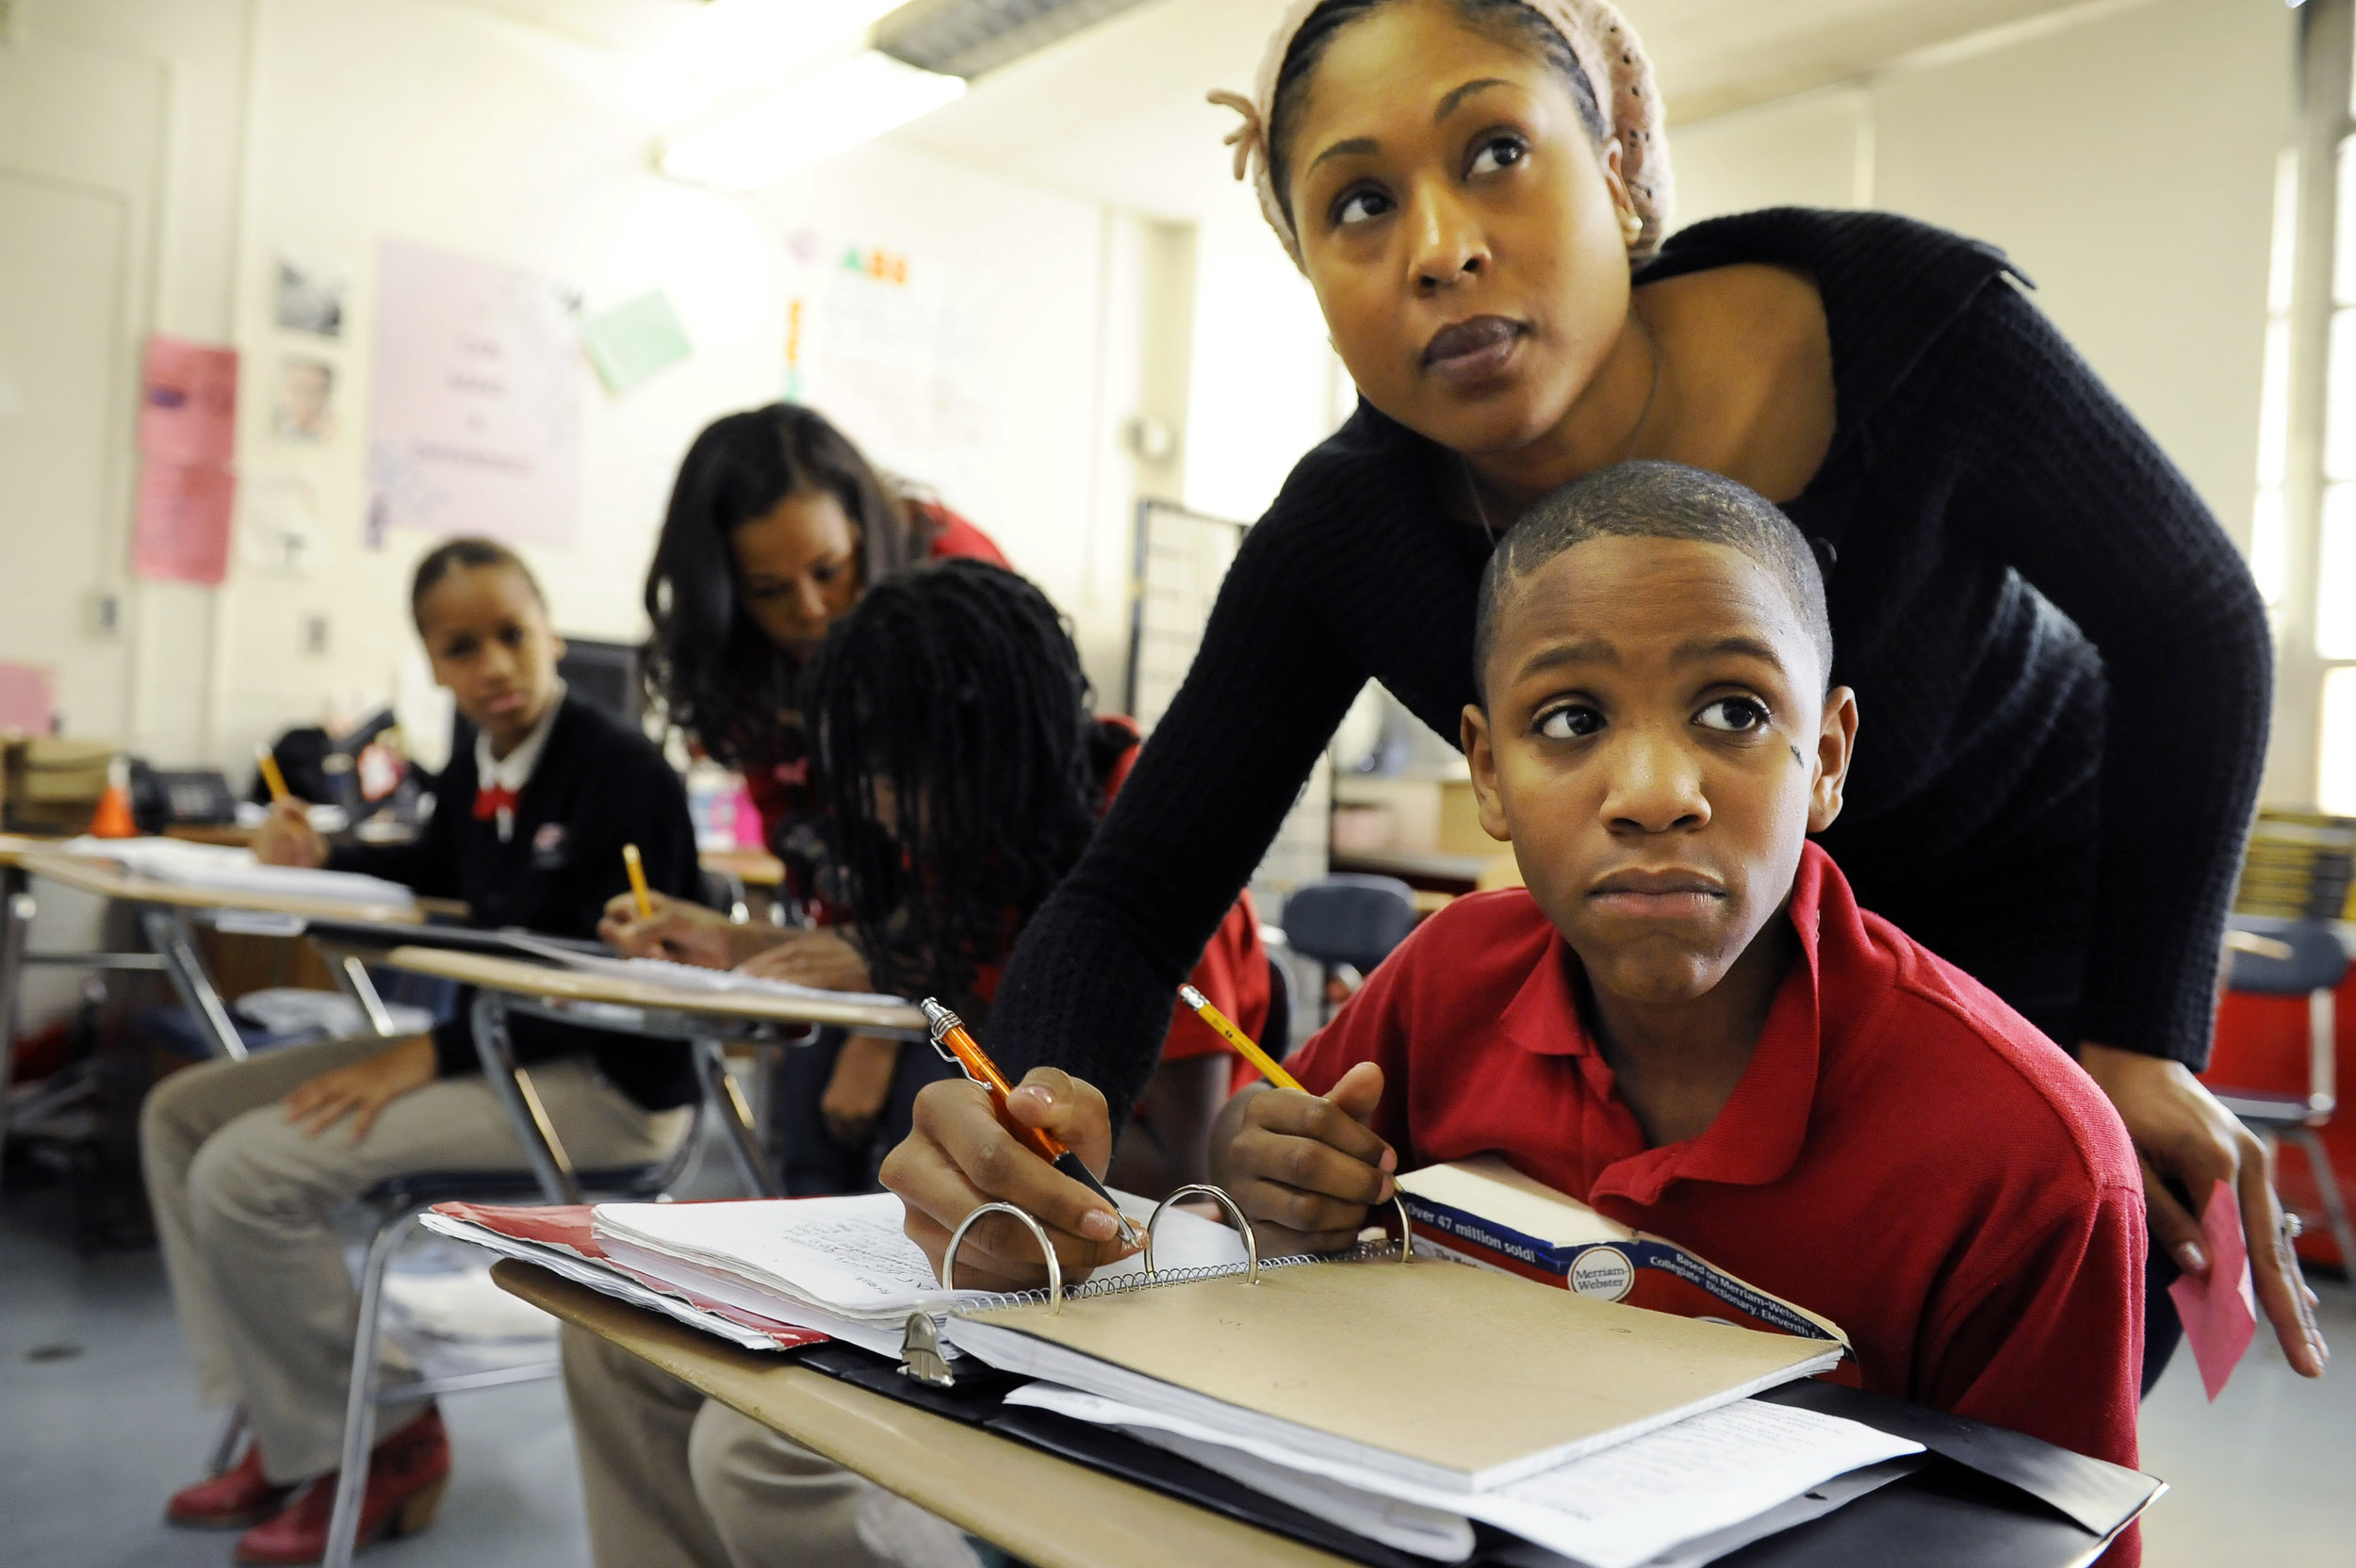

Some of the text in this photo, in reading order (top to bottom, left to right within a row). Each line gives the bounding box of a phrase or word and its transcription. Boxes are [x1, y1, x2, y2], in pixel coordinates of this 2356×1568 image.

[1407, 1202, 1536, 1263] Over 47 million sold!
[1576, 1268, 1628, 1280] Merriam-
[1677, 1253, 1705, 1275] Based
[1706, 1271, 1719, 1283] on
[1578, 1279, 1623, 1290] Webster
[1761, 1308, 1809, 1337] Eleventh
